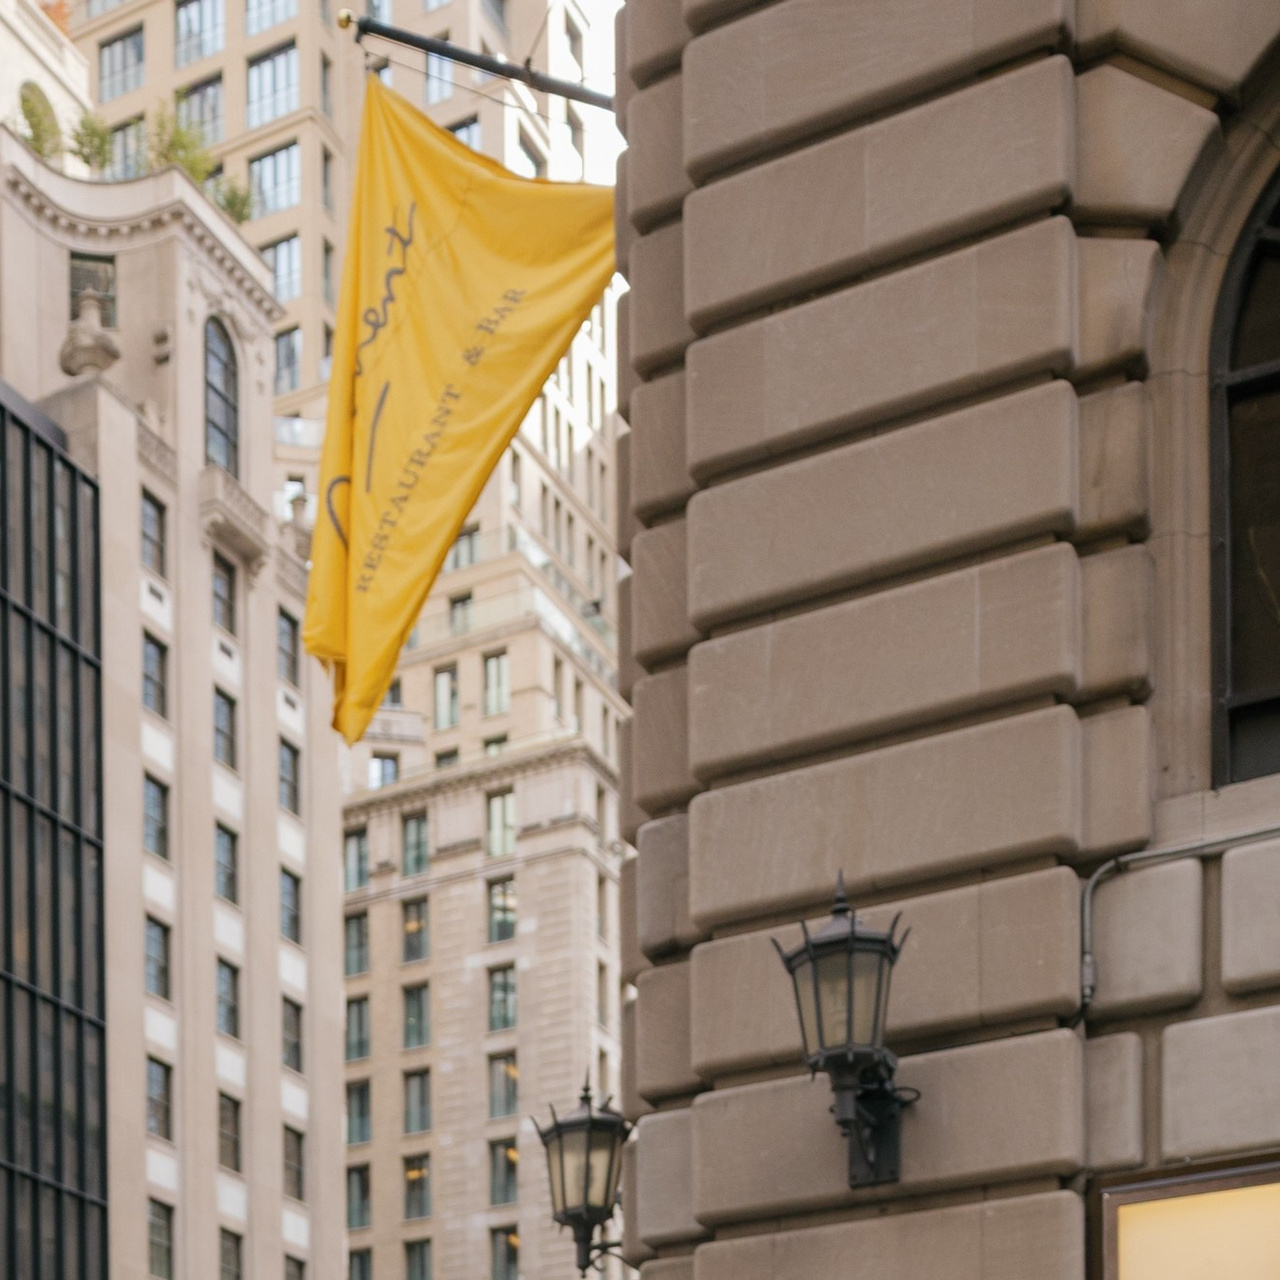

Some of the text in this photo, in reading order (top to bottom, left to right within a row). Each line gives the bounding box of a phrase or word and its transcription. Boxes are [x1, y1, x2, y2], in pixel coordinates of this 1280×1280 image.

[356, 286, 525, 593] RESTAURANT & BAR
